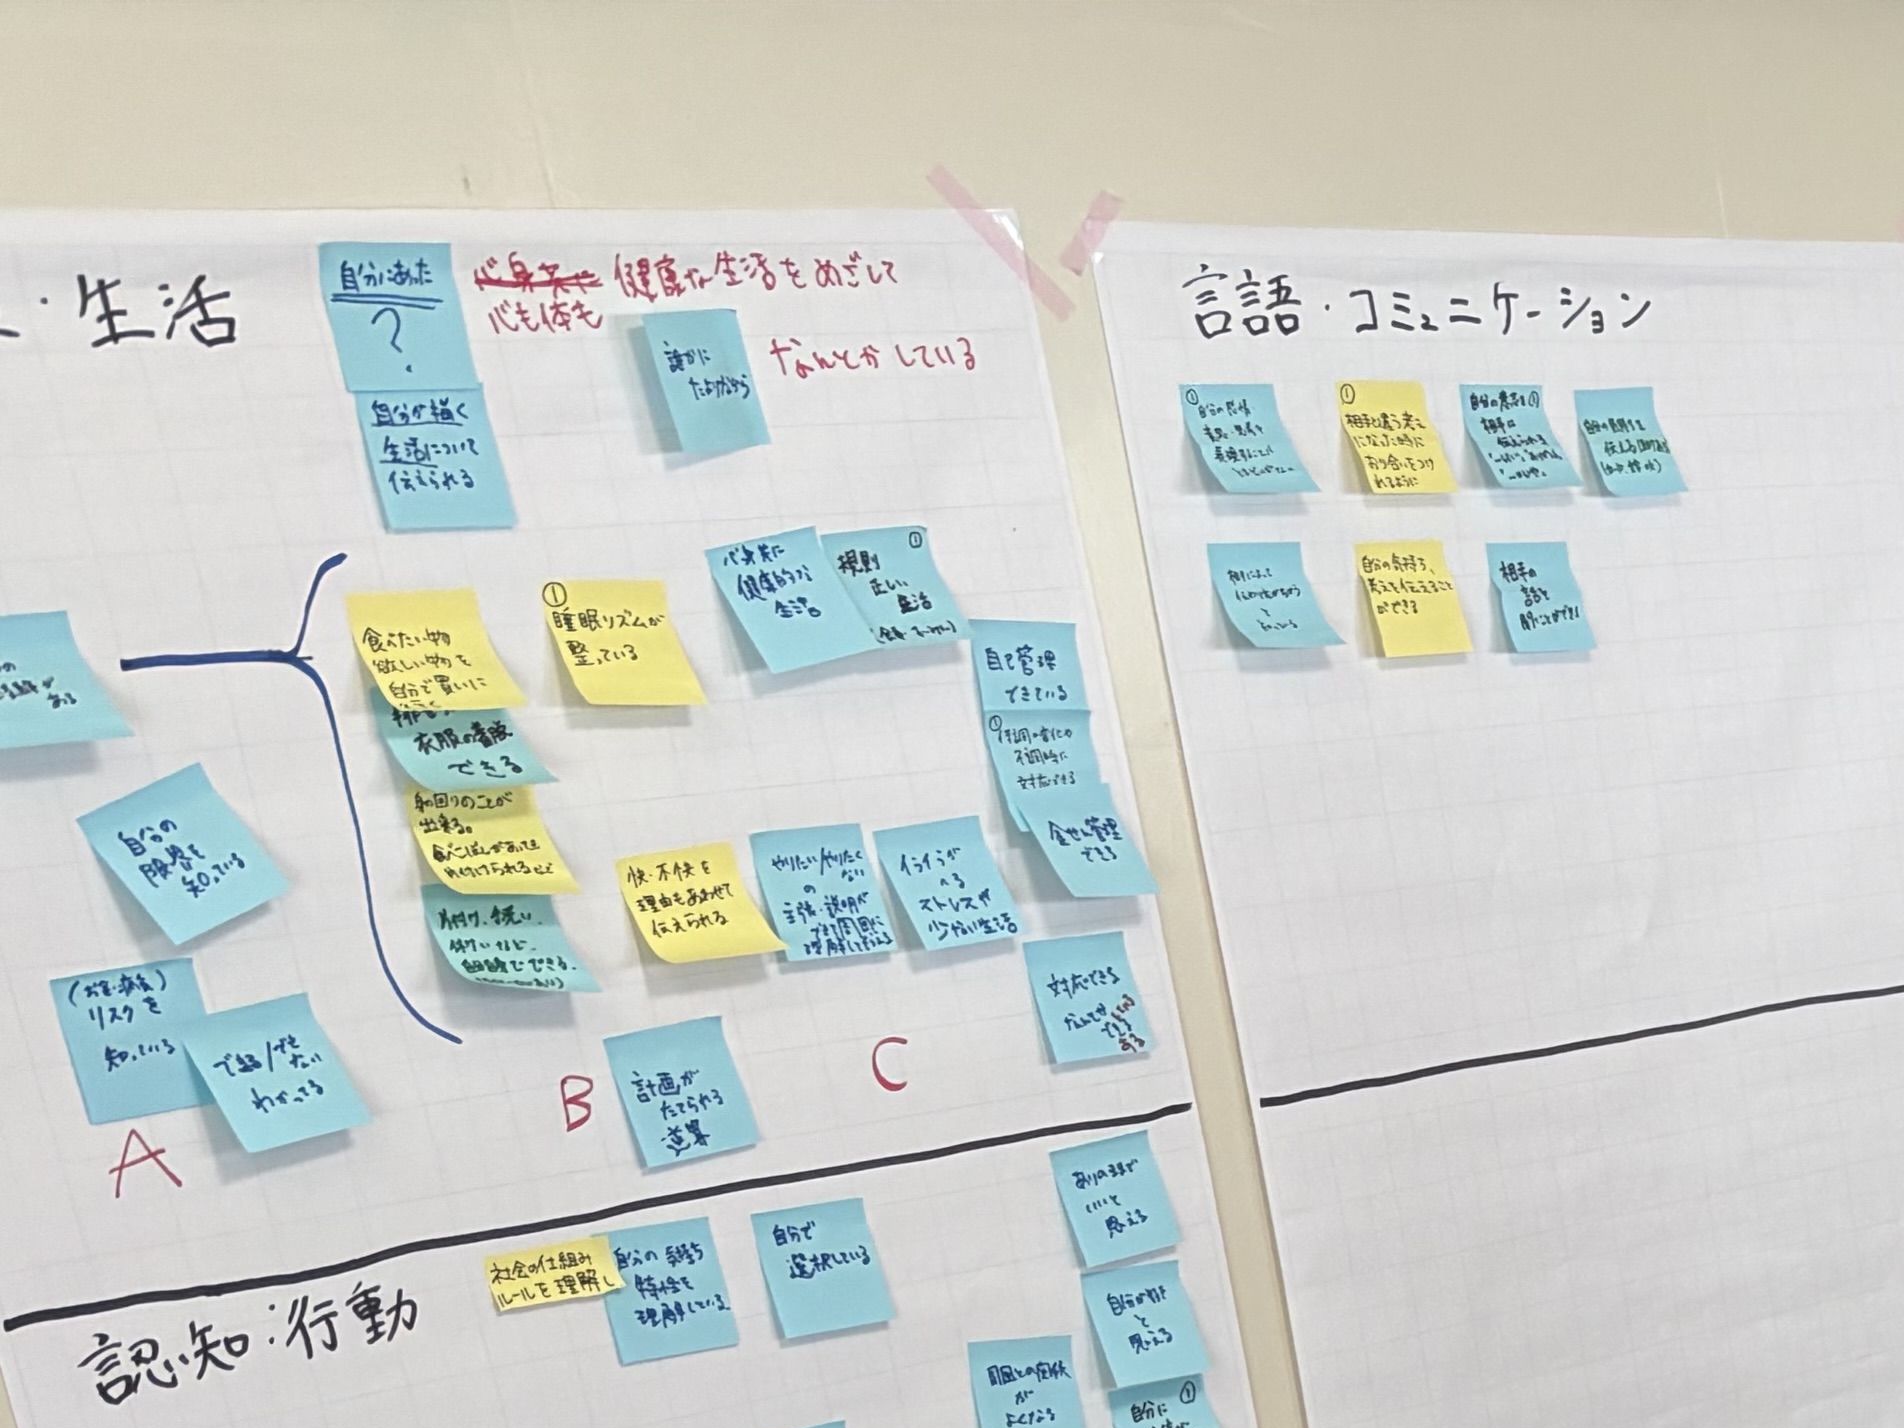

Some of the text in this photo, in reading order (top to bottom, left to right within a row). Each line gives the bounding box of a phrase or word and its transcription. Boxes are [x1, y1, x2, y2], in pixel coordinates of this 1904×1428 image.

[614, 250, 899, 302] 健康な生活をめざして
[488, 300, 603, 334] 心も体も
[1182, 264, 1653, 338] 言語・コミュニケーション
[552, 608, 666, 632] 睡眠リズムが
[448, 756, 523, 778] できる
[872, 1037, 908, 1092] C
[561, 1072, 594, 1133] B
[109, 1128, 182, 1198] A
[772, 1221, 816, 1246] 自分で
[491, 1251, 593, 1285] 社会の仕組み
[1131, 1400, 1168, 1423] 自分に
